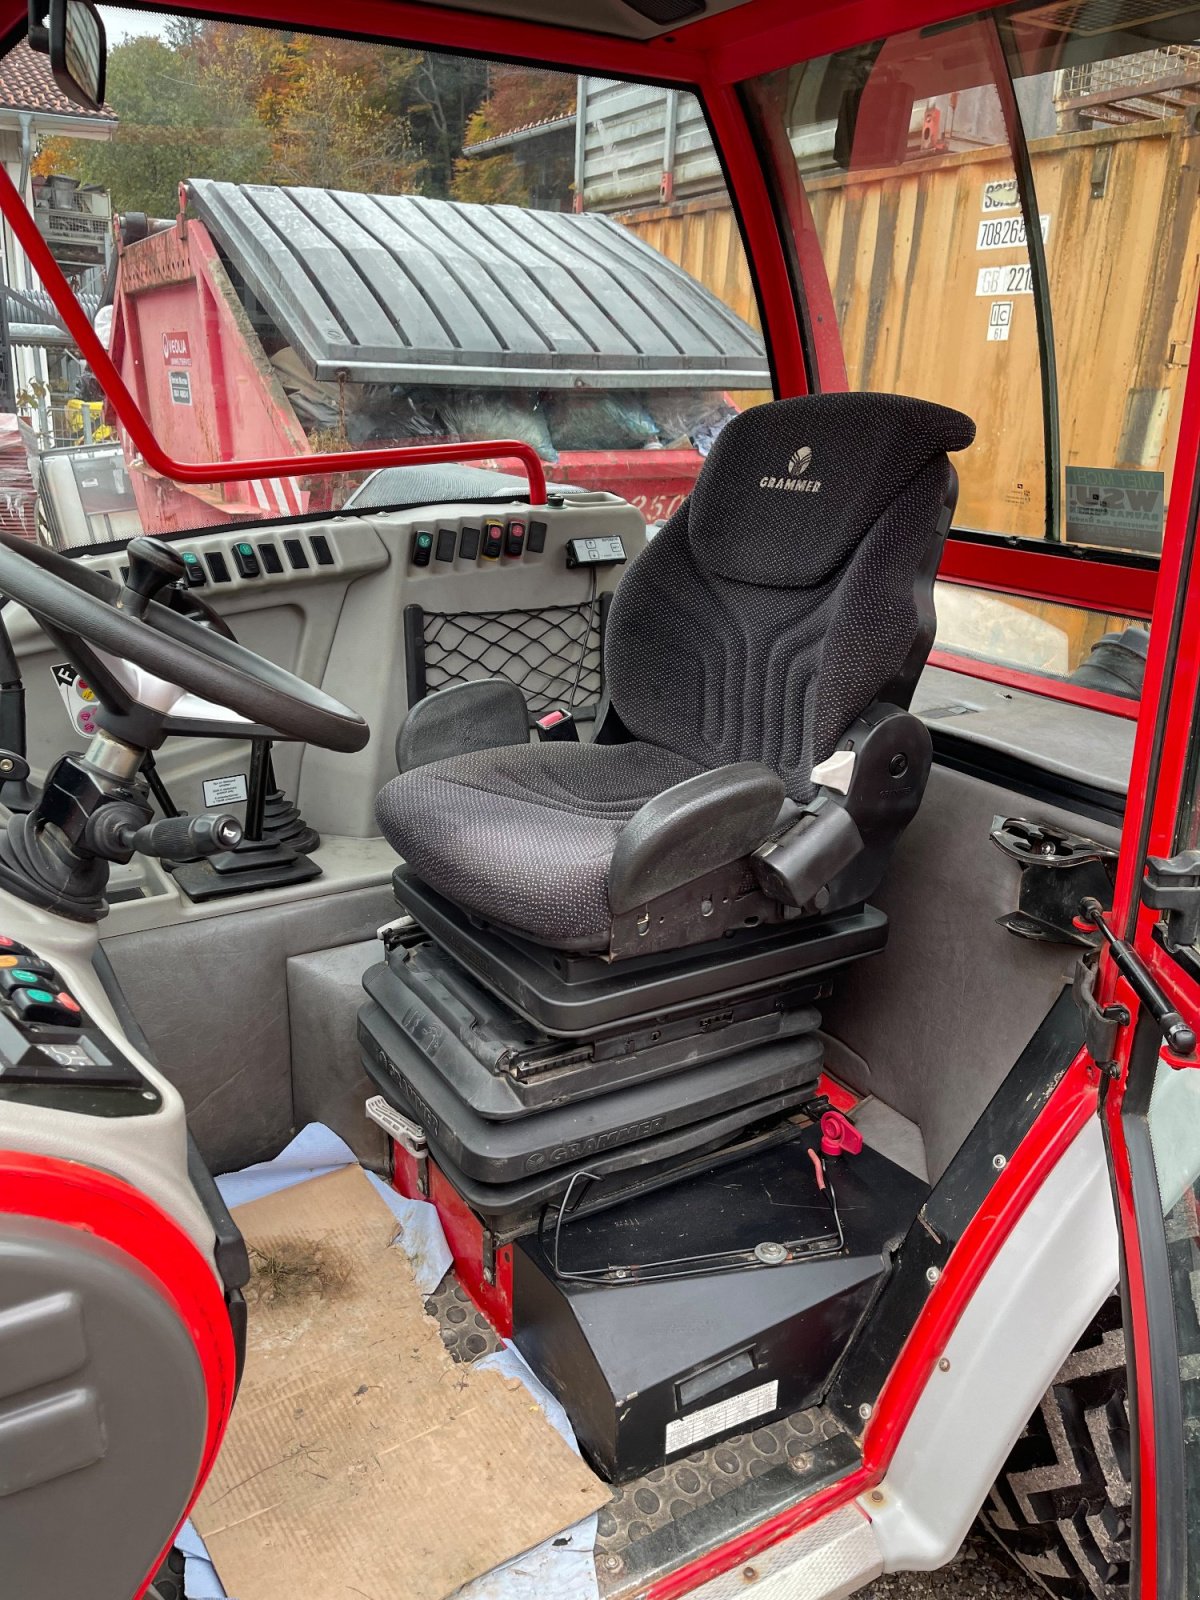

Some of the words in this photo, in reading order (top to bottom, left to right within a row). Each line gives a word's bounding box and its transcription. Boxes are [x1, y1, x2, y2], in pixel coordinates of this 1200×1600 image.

[982, 270, 1000, 293] GB
[758, 476, 822, 493] GRAMMER
[549, 1116, 664, 1162] GRAMMER
